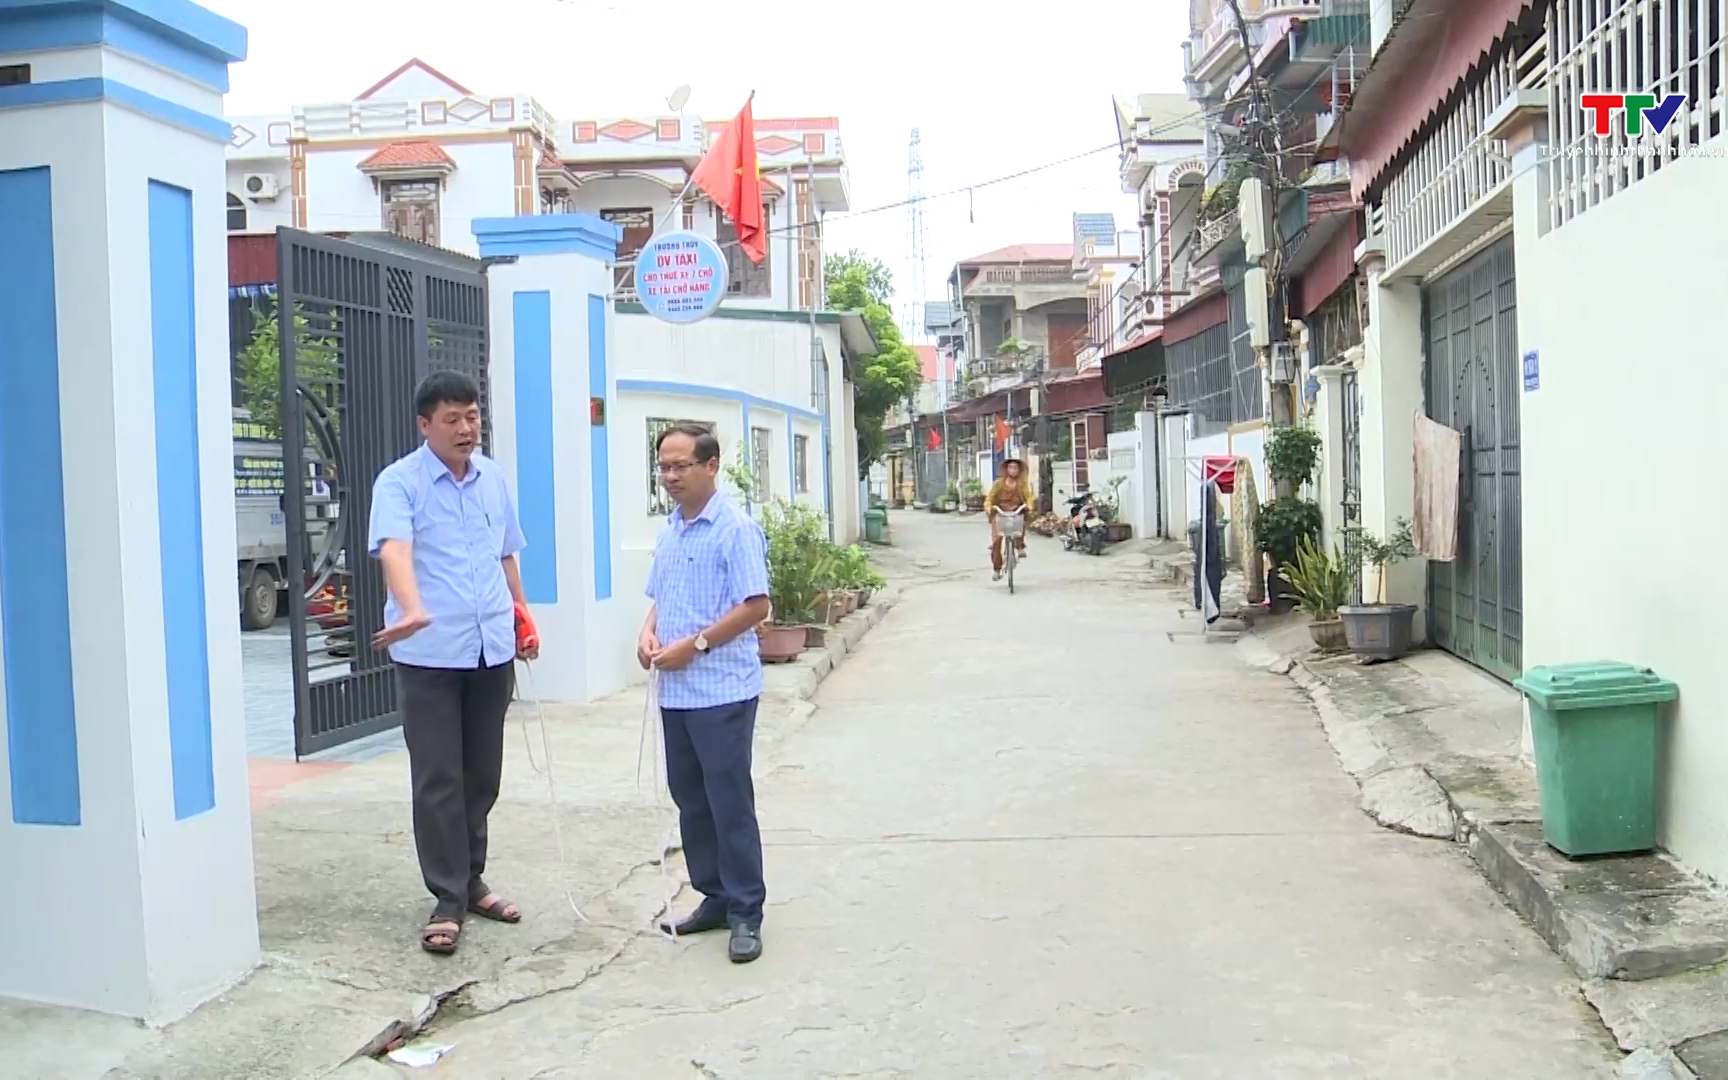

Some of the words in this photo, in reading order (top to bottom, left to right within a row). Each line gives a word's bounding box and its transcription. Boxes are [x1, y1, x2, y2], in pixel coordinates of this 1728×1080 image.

[657, 255, 671, 267] DV
[675, 253, 697, 266] TAXI
[643, 273, 658, 282] CHO
[680, 271, 689, 280] XE
[648, 287, 657, 296] XE
